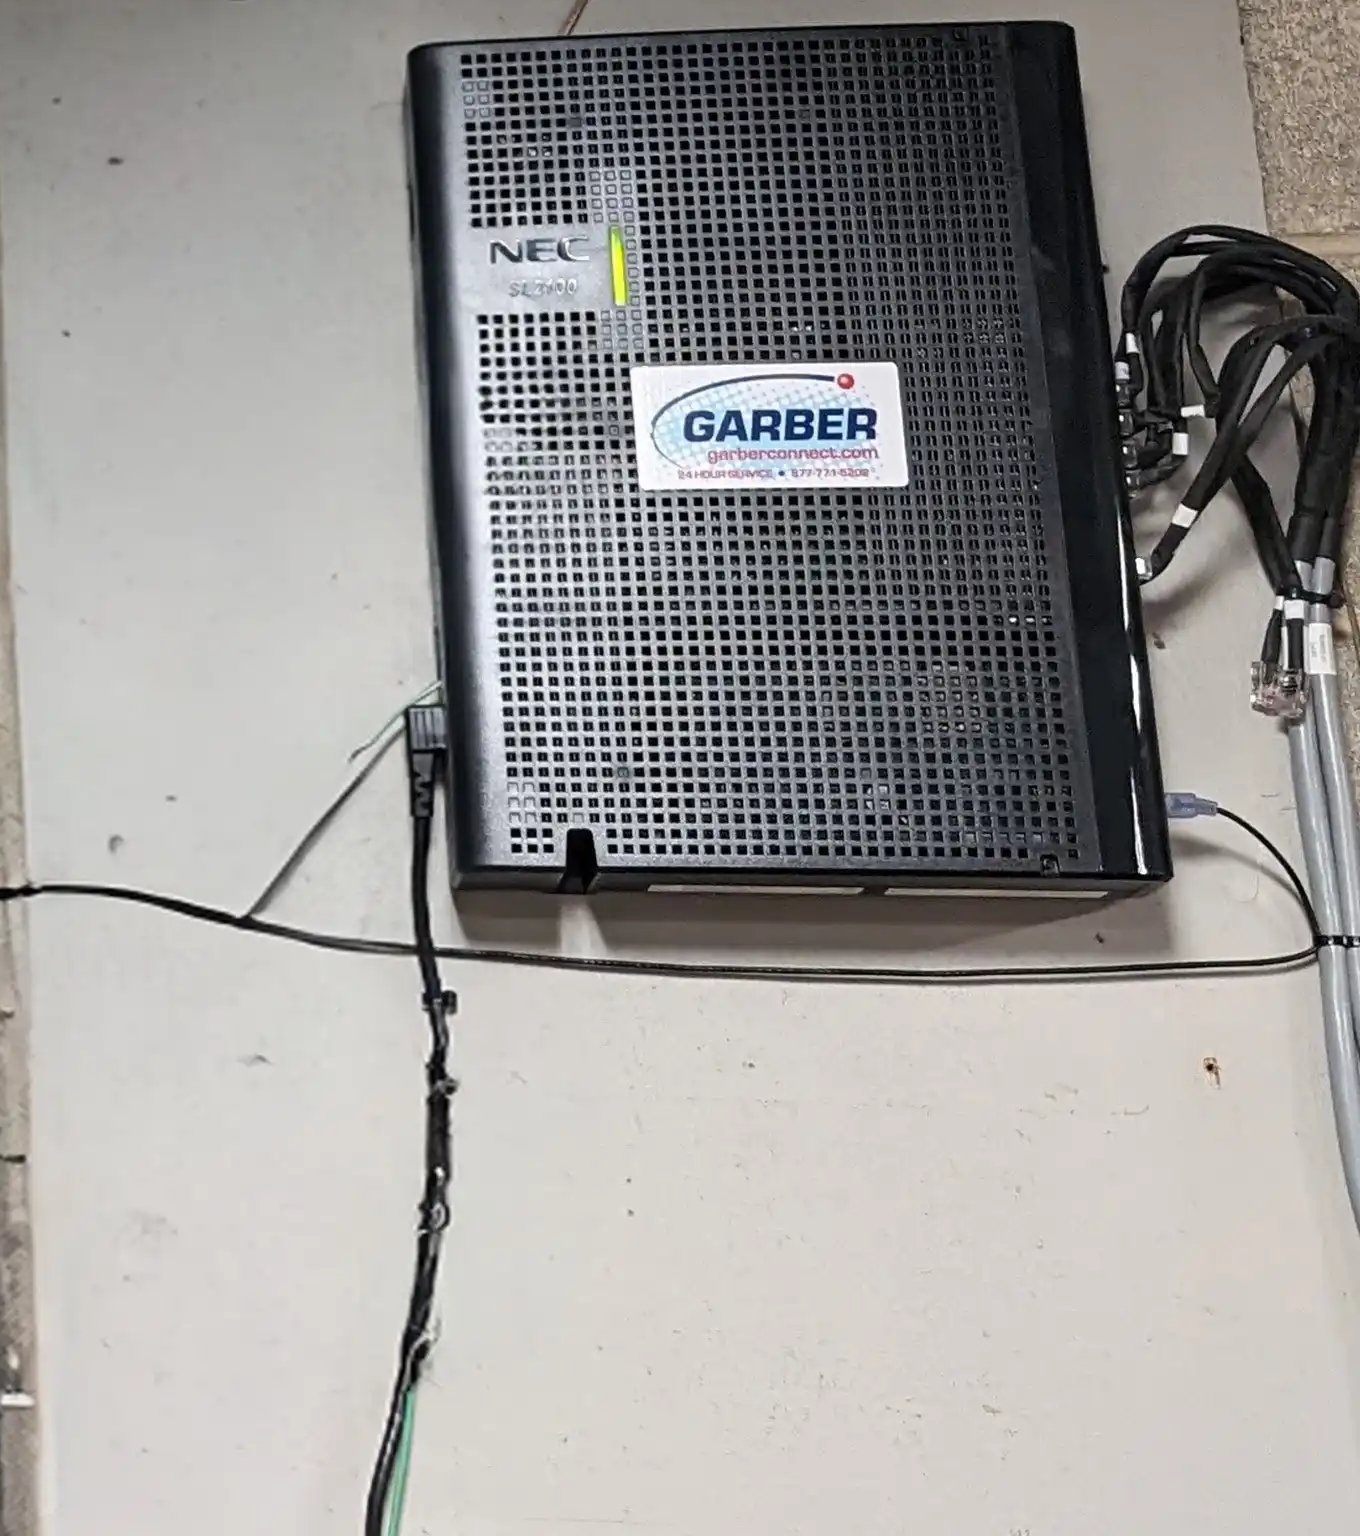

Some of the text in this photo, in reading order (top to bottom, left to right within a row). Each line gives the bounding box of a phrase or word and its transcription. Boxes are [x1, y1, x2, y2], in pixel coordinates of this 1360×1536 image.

[489, 234, 591, 265] NEC
[683, 408, 878, 443] GARBER
[707, 447, 880, 465] garberconnect.com
[694, 470, 726, 479] HOUR
